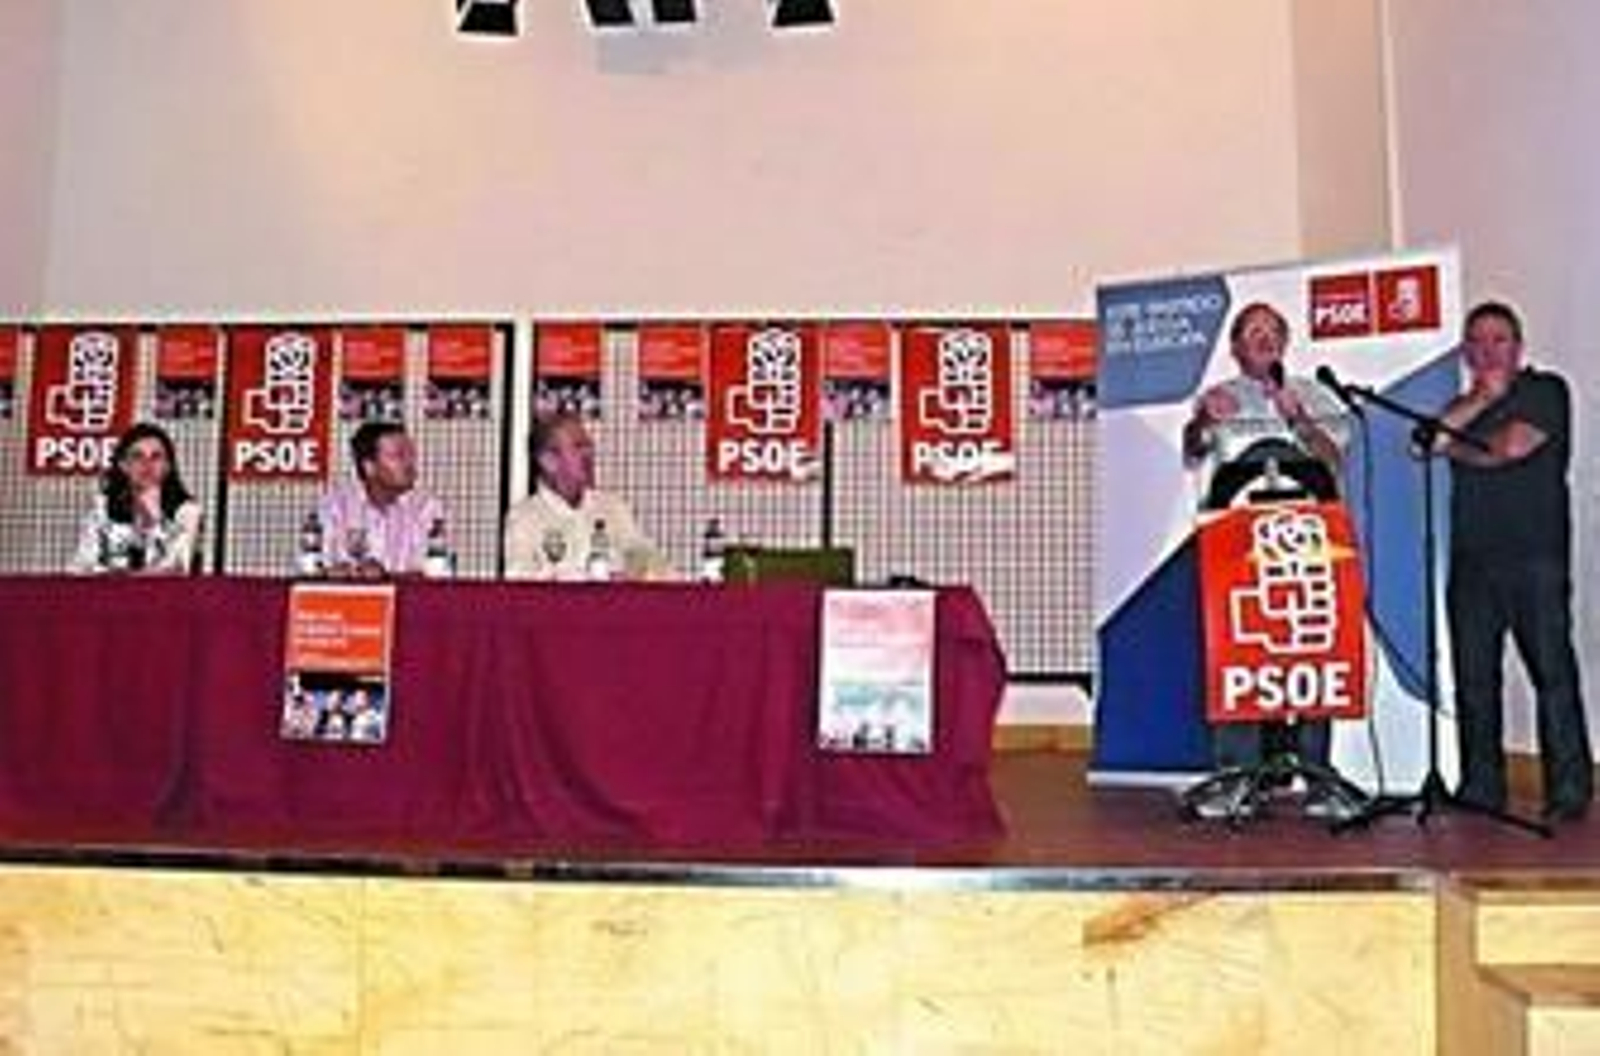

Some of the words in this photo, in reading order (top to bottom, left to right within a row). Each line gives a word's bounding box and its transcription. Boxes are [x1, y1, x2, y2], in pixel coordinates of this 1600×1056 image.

[1315, 302, 1366, 327] PSOE
[233, 440, 320, 472] PSOE
[718, 440, 815, 477] PSOE
[1222, 661, 1351, 711] PSOE
